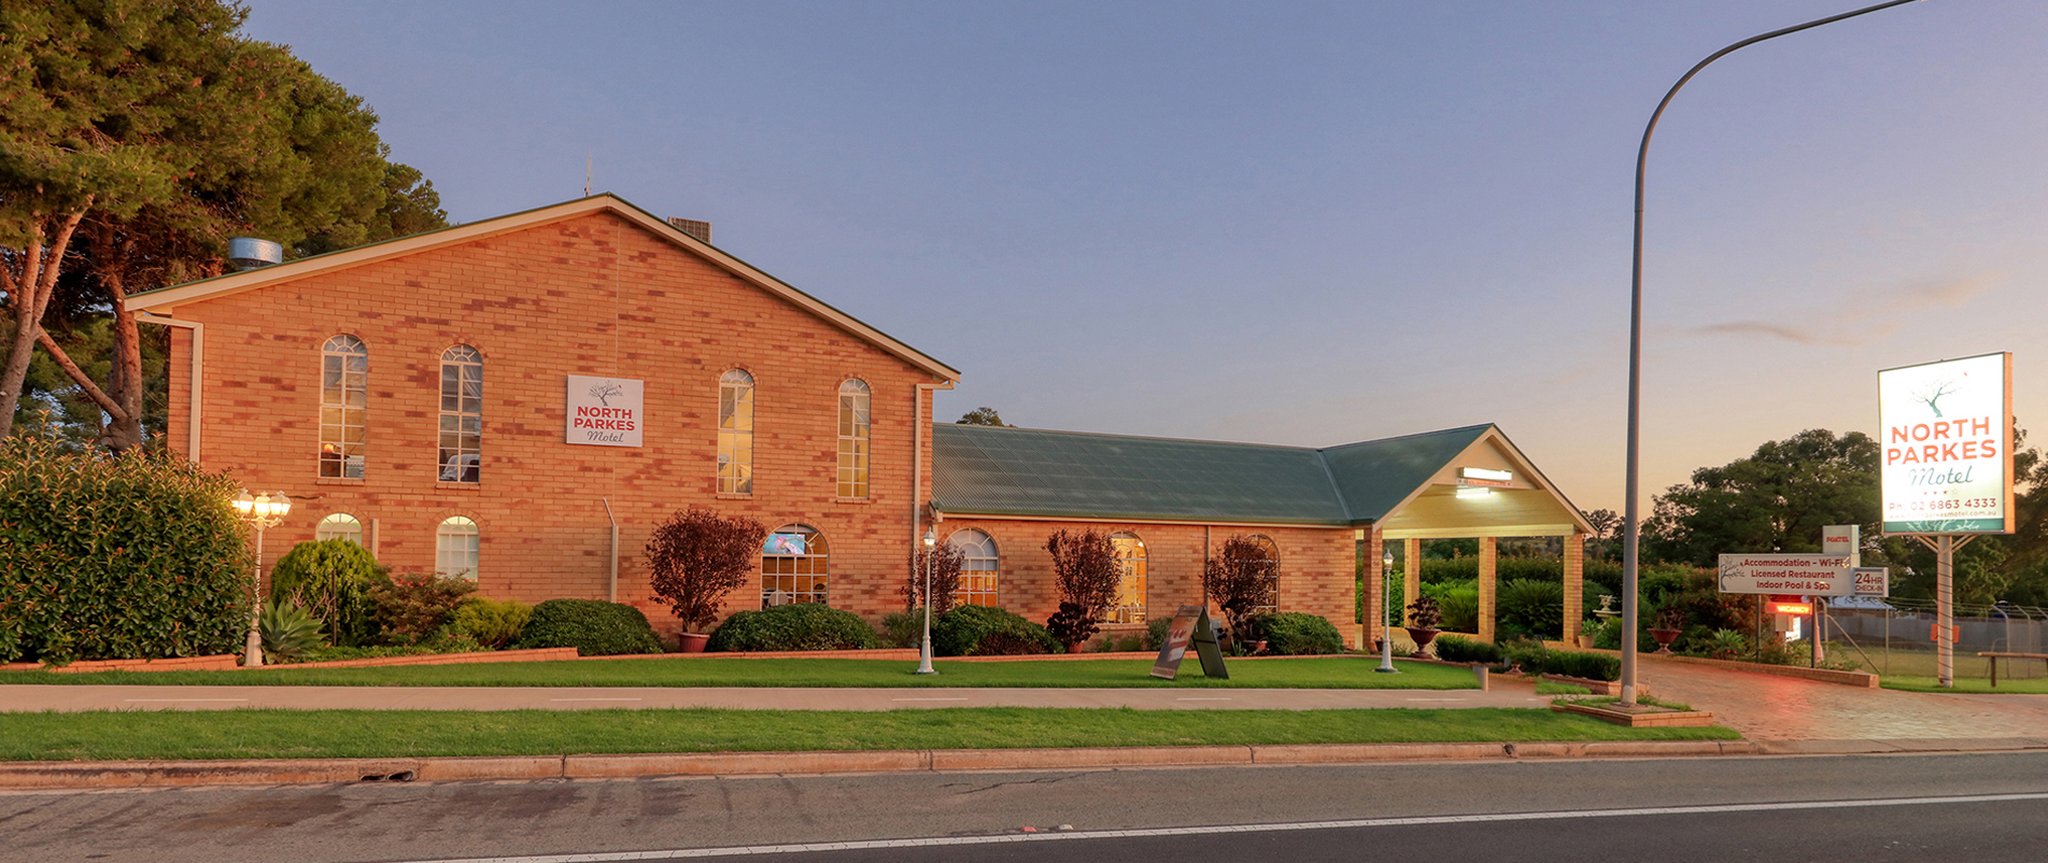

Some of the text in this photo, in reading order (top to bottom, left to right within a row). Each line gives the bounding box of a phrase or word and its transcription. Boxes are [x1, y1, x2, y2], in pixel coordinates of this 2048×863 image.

[577, 406, 632, 419] NORTH
[574, 418, 635, 431] PARKES
[1892, 417, 1989, 443] NORTH
[587, 431, 624, 442] Motel
[1888, 439, 1997, 466] PARKES
[1909, 465, 1974, 486] Motel
[1910, 502, 1925, 511] 02
[1929, 500, 1960, 510] 6863
[1964, 498, 1997, 508] 4333
[1744, 559, 1811, 567] Accommodation
[1751, 569, 1835, 579] Licensed Restaurant
[1756, 581, 1783, 589] Indoor
[1785, 581, 1804, 589] Pool
[1814, 582, 1831, 591] Spa
